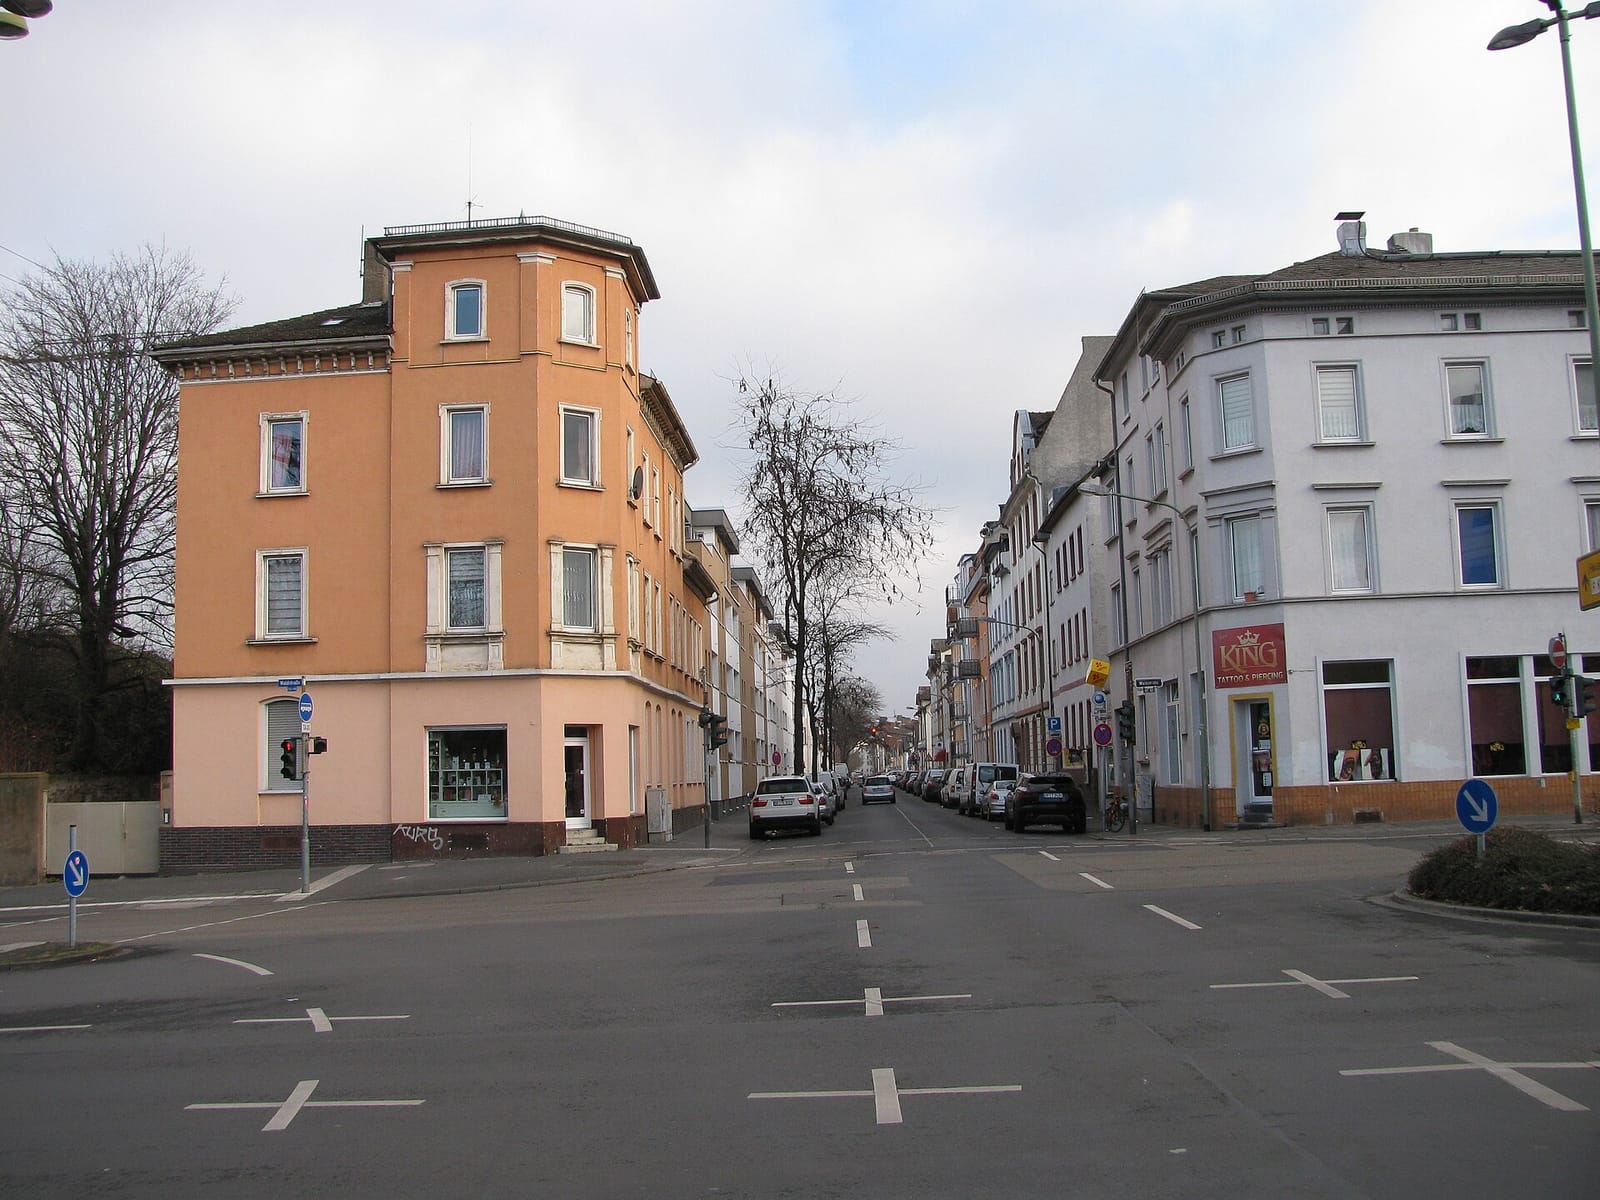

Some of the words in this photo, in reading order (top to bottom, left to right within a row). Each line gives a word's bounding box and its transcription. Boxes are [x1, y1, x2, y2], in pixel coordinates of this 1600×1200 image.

[1220, 641, 1278, 673] KING
[1217, 675, 1244, 684] TATTOO
[1251, 671, 1284, 681] PIERCING
[1050, 718, 1058, 729] P
